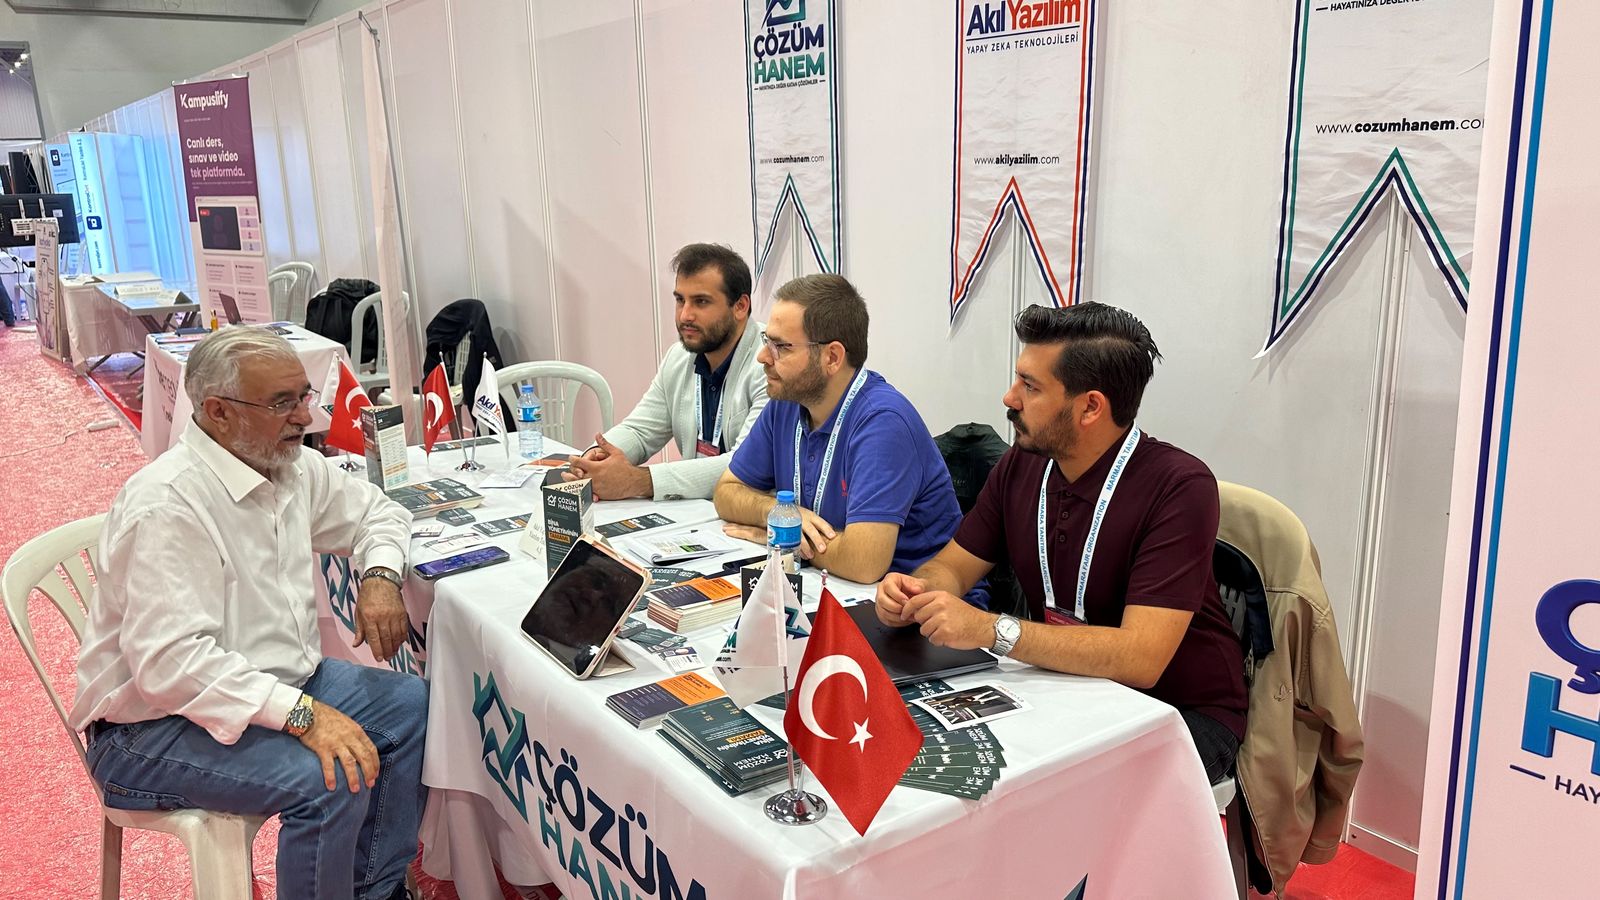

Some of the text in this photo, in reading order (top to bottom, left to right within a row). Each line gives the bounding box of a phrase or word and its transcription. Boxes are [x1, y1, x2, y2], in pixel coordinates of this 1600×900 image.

[754, 22, 824, 64] ÇÖZÜM
[966, 31, 1079, 54] YAPAY ZEKA TEKNOLOJİLERİ
[754, 51, 825, 84] HANEM
[180, 90, 229, 111] Kampuslify
[186, 136, 224, 149] Canlı ders,
[188, 150, 239, 163] sınav ve video
[760, 155, 825, 164] www.cozumhanem.com
[974, 153, 1060, 166] www.akilyazilim.com
[190, 166, 246, 181] tek platformda.
[818, 478, 826, 491] FAIR
[822, 433, 837, 477] ORGANIZATION
[1106, 454, 1127, 491] MARMARA
[557, 497, 578, 508] ÇÖZÜM
[557, 503, 578, 513] HANEM
[1077, 499, 1107, 606] MARMARA FAIR ORGANIZATION
[733, 752, 769, 767] HANEM
[737, 757, 773, 770] ÇÖZÜM
[533, 740, 707, 900] ÇÖZÜM
